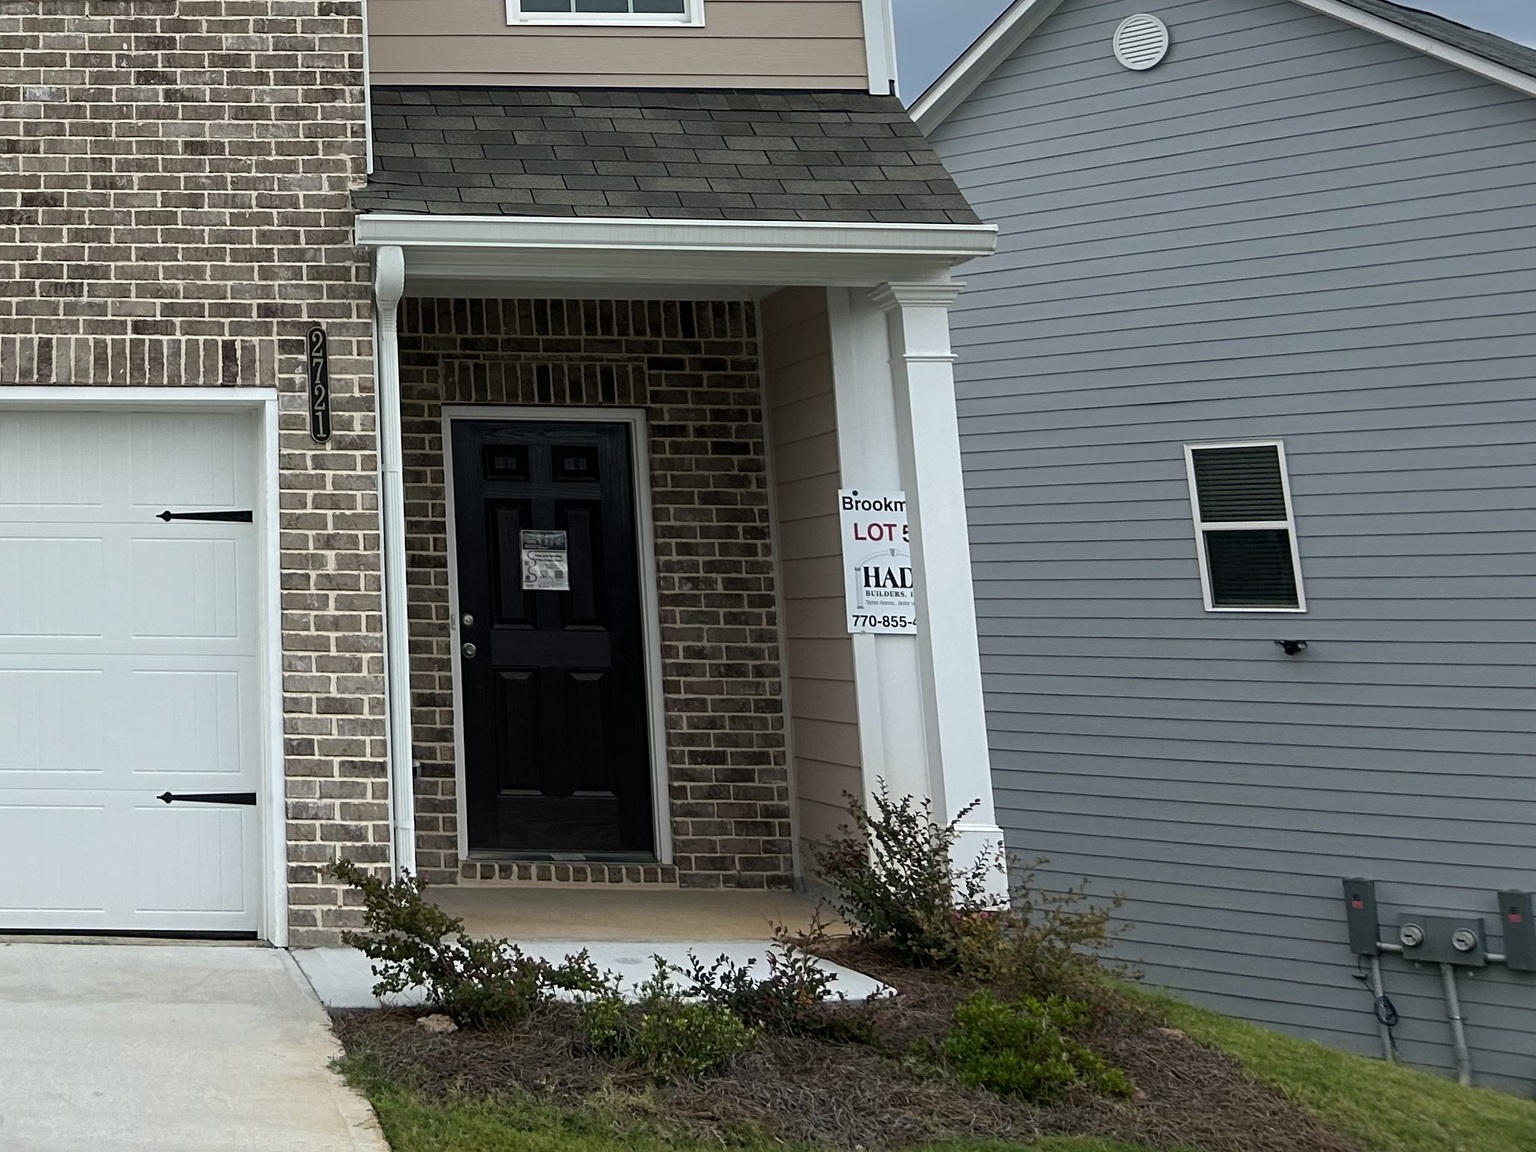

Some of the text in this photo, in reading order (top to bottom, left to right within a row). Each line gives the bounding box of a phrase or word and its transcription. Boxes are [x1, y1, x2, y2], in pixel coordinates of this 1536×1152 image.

[311, 330, 327, 437] 2721
[853, 522, 897, 542] LOT
[863, 566, 914, 588] HAD
